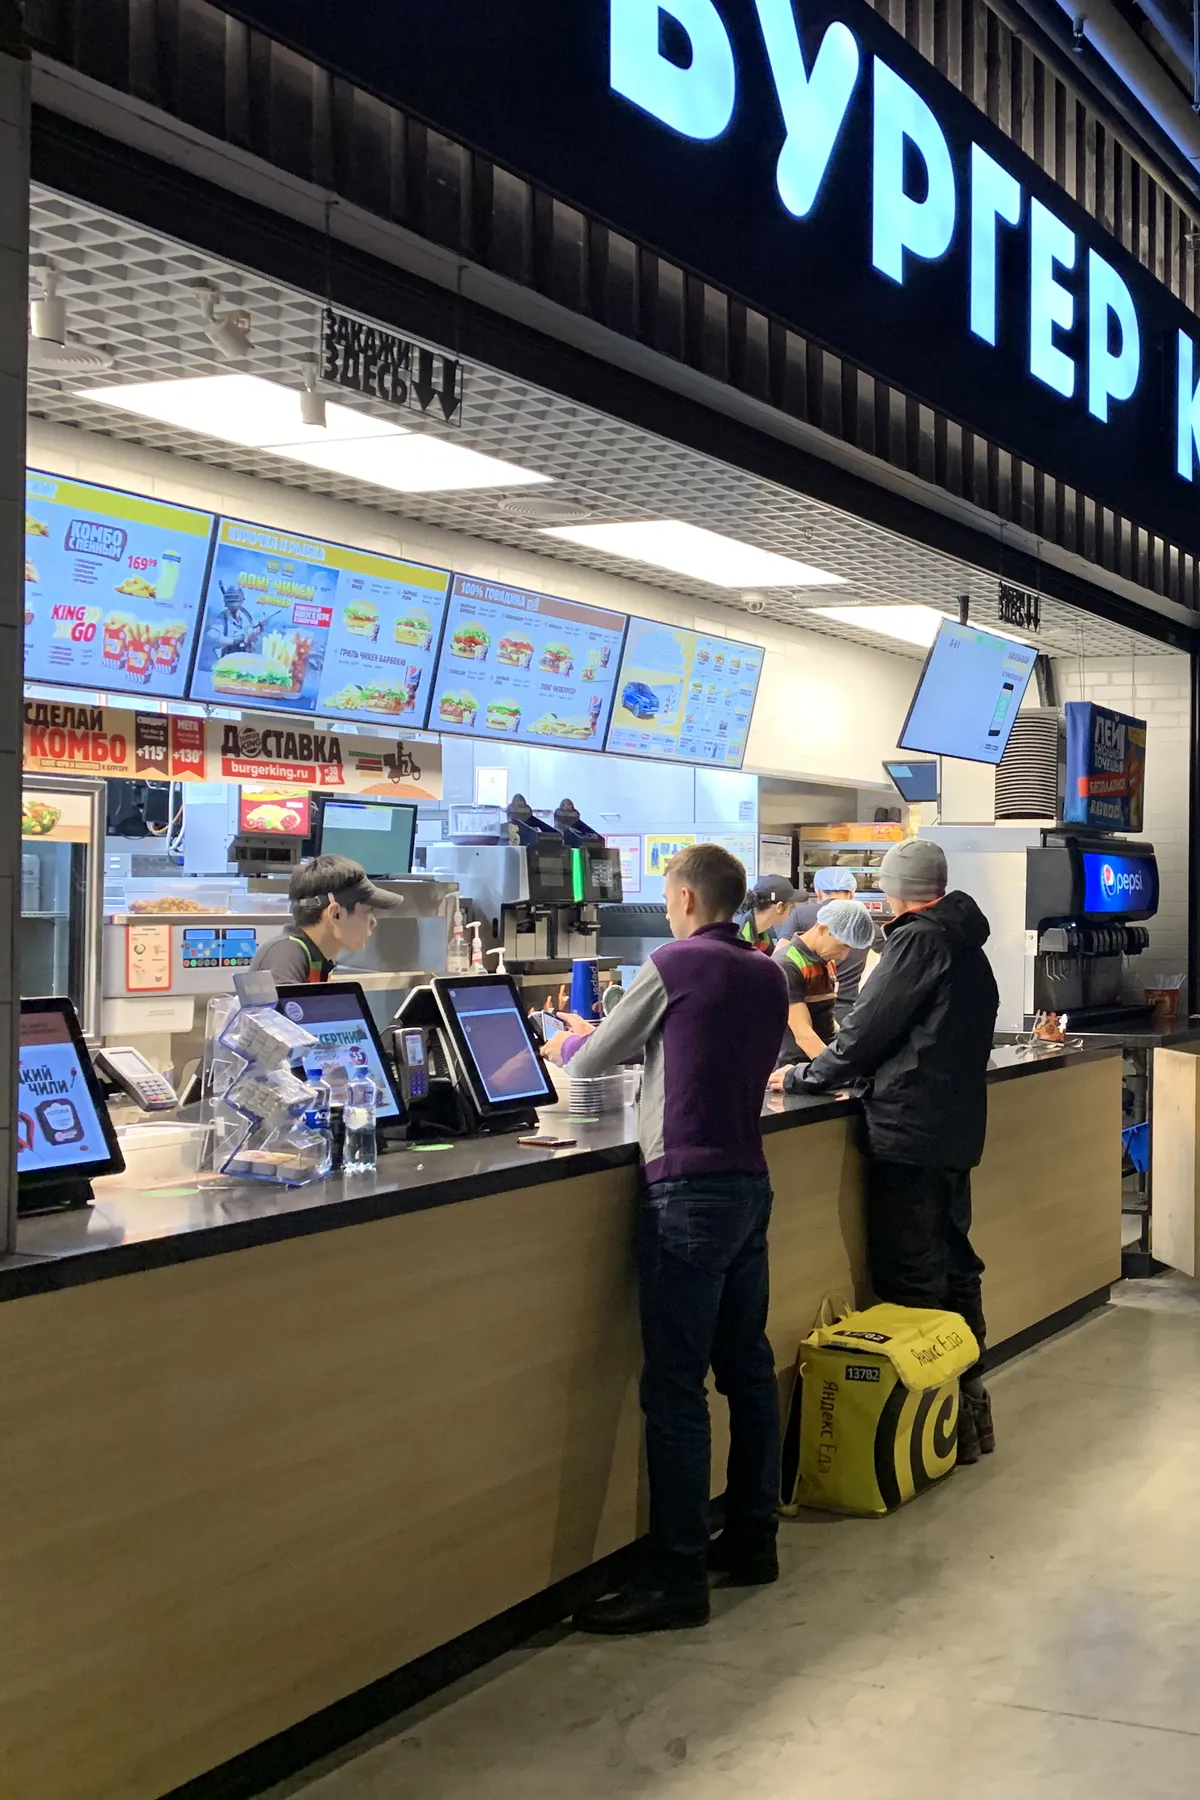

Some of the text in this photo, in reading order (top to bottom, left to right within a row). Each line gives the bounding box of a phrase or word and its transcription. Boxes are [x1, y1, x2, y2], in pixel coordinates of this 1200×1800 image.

[324, 345, 408, 404] ЗДЕСЬ
[71, 521, 123, 546] КОМБО
[461, 581, 484, 598] 100%
[485, 586, 526, 607] ГОВЯДИНА
[51, 604, 86, 622] KING
[71, 622, 97, 642] GO
[339, 648, 358, 659] ГРИЛЬ
[359, 651, 379, 663] ЧИКЕН
[379, 654, 407, 667] БАРБЕКЮ
[25, 701, 104, 732] СДЕЛАЙ
[30, 725, 127, 764] КОМБО
[231, 760, 309, 780] burgerking.ru
[1116, 870, 1143, 895] pepsi
[589, 965, 600, 996] pepsi
[20, 1064, 53, 1086] КИЙ
[28, 1079, 69, 1096] ЧИЛИ
[935, 1331, 964, 1352] Еда
[847, 1367, 879, 1381] 13782
[816, 1379, 839, 1475] Яндекс Еда
